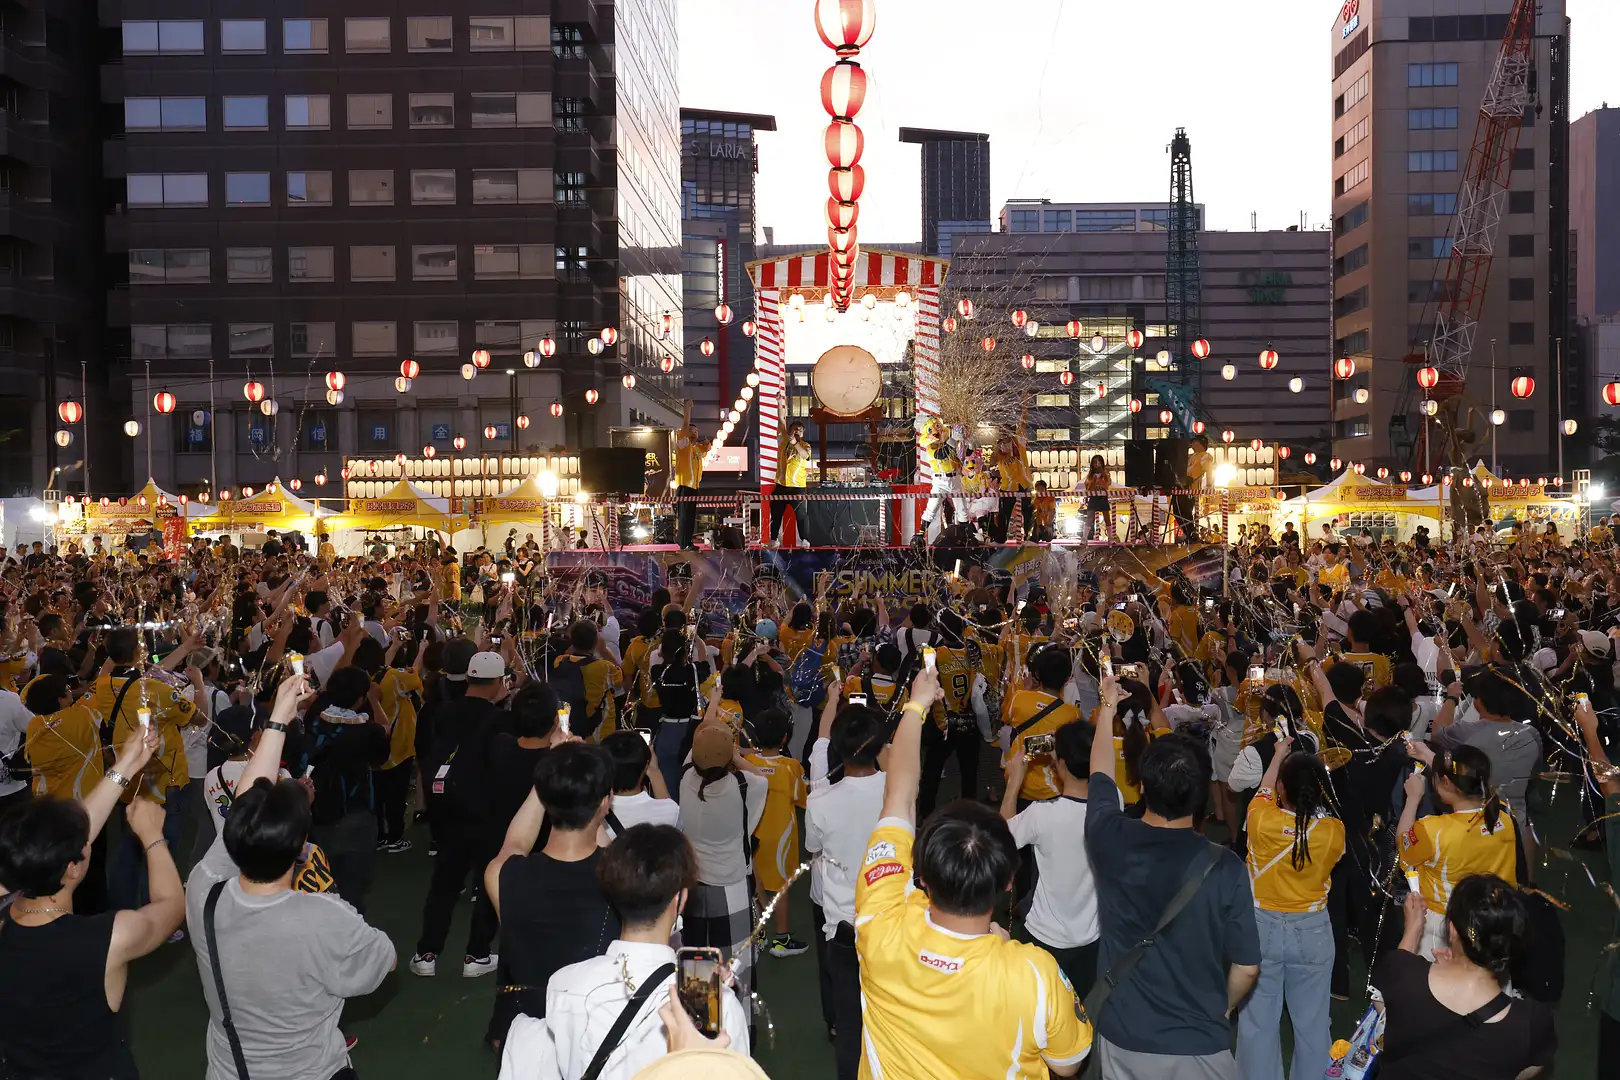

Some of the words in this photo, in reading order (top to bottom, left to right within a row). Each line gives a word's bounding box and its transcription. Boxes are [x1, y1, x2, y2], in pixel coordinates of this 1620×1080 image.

[691, 140, 746, 159] SLARIA
[838, 570, 936, 594] SUMMER
[952, 674, 968, 698] 9
[920, 955, 959, 971] ロックアイス
